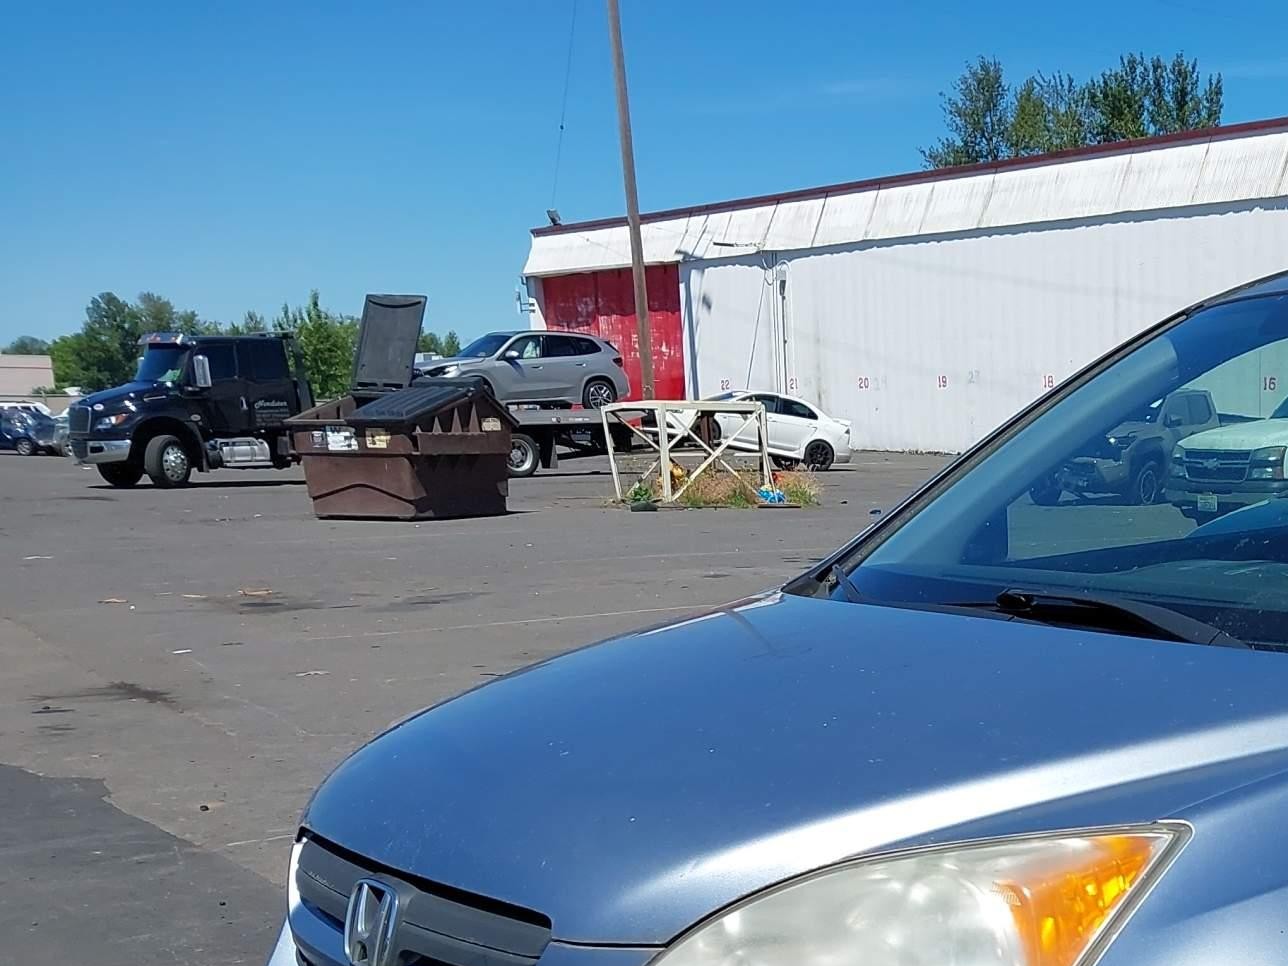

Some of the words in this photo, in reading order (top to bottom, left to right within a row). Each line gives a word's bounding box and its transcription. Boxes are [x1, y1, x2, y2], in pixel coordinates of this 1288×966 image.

[720, 379, 730, 391] 22
[789, 378, 798, 390] 21
[858, 377, 870, 389] 20
[938, 375, 948, 388] 19
[1043, 375, 1054, 389] 18
[1263, 376, 1277, 391] 16
